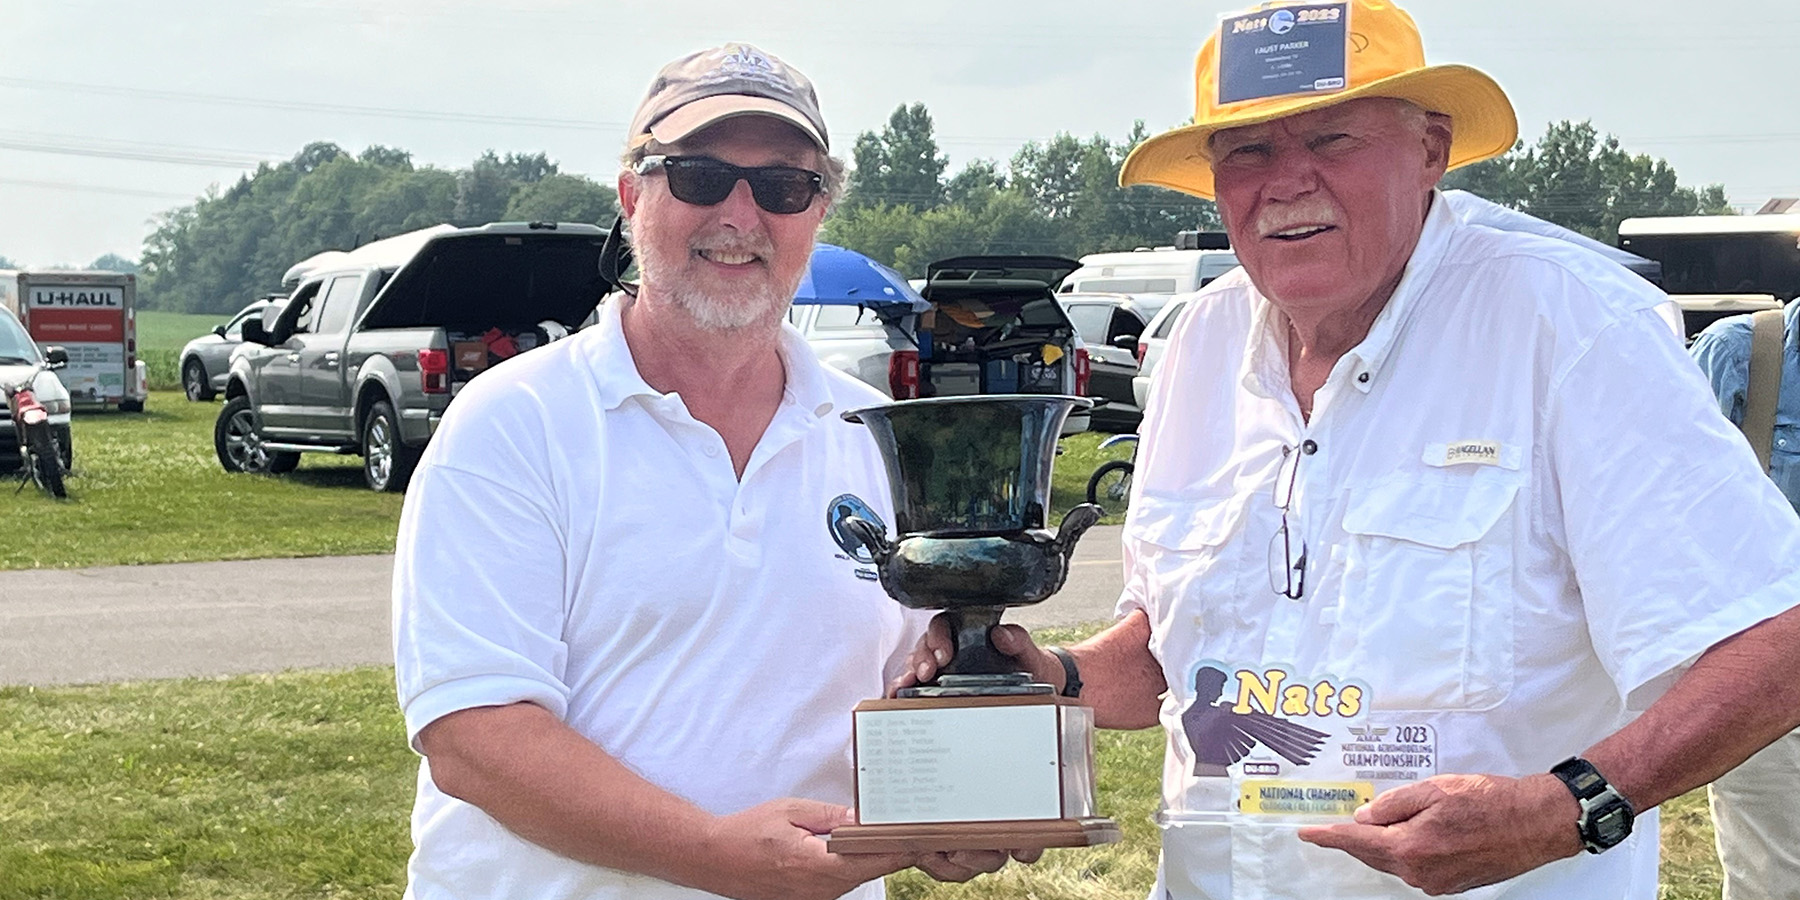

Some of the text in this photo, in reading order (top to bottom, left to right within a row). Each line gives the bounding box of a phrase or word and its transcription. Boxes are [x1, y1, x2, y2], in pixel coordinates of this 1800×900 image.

[1297, 8, 1340, 22] 2023
[1279, 41, 1309, 51] PARKER
[37, 292, 116, 306] U-HAUL
[1233, 669, 1363, 718] Nats
[1396, 726, 1427, 743] 2023
[1341, 744, 1375, 752] NATIONAL
[1343, 753, 1432, 768] CHAMPIONSHIPS
[1259, 787, 1357, 801] NATIONAL CHAMPION
